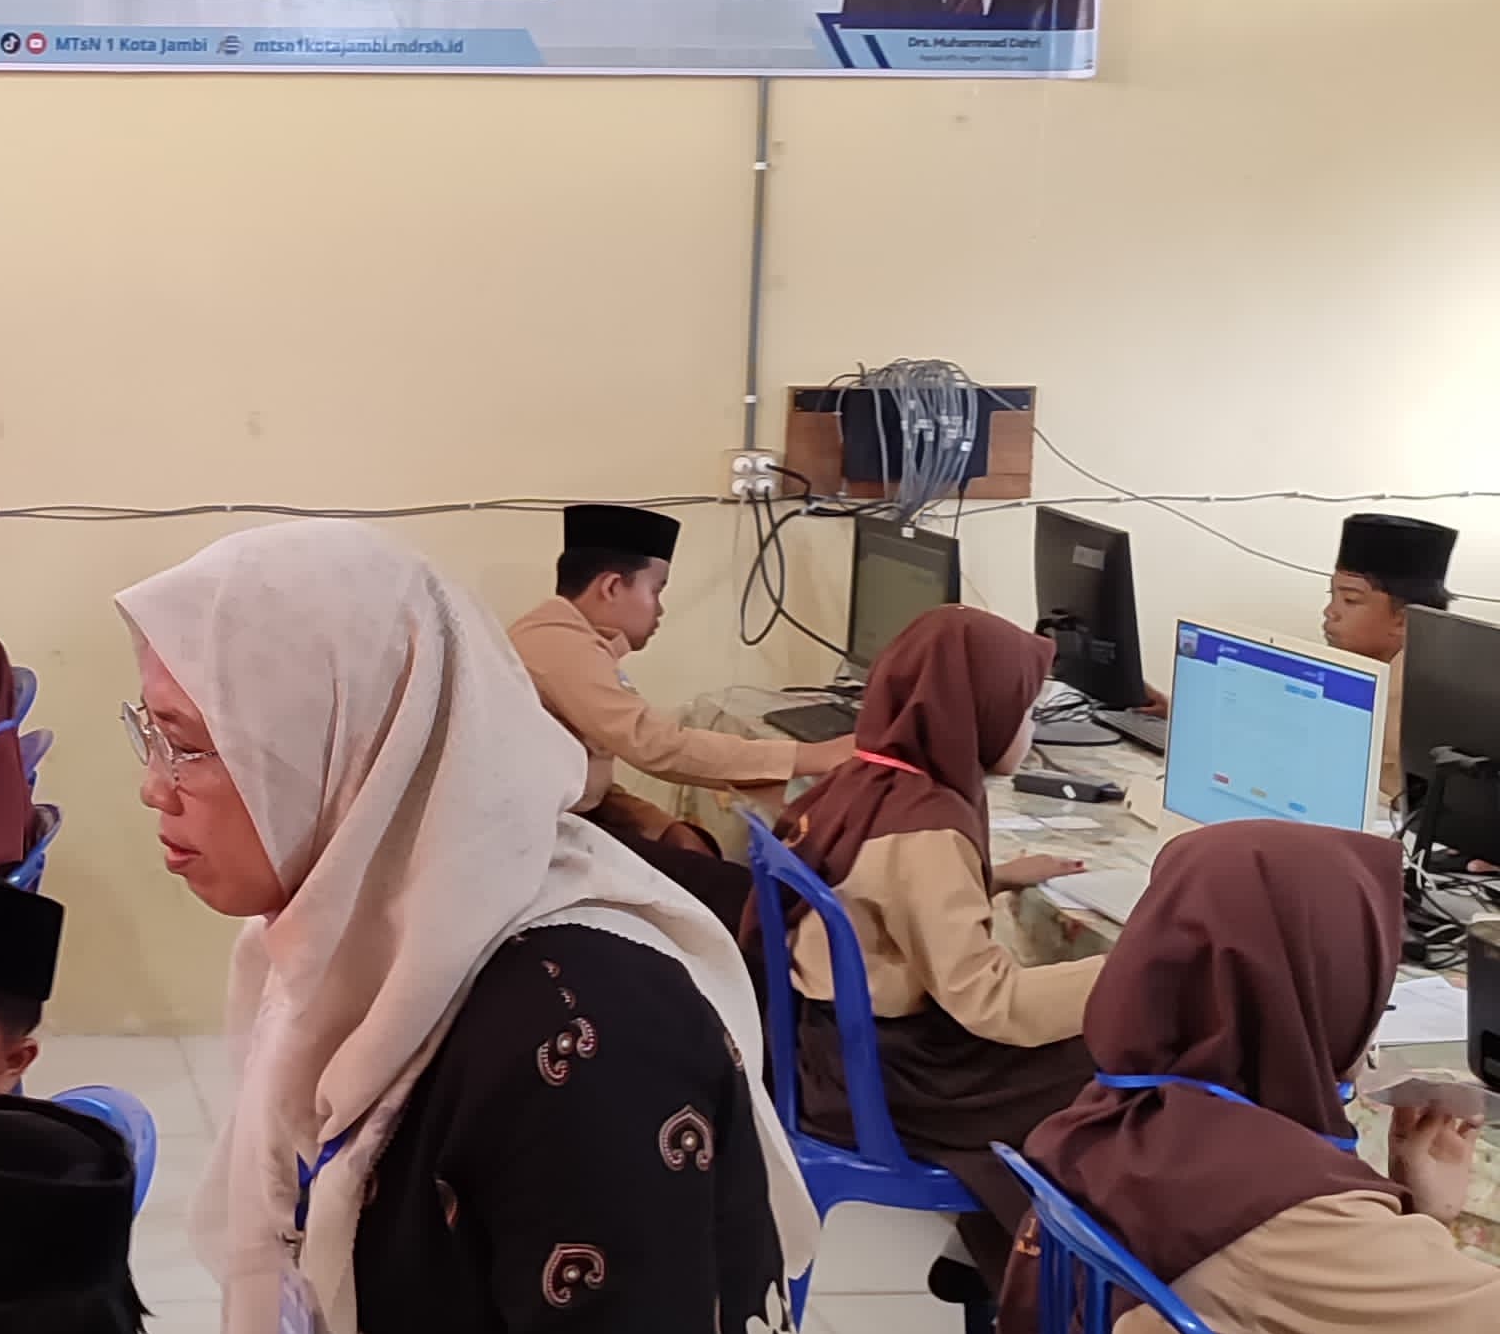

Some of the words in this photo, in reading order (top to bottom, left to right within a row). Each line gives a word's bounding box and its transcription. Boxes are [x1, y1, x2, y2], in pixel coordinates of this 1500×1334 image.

[55, 37, 101, 53] MTsN
[107, 37, 115, 53] 1
[118, 37, 157, 53] Kota
[158, 37, 208, 56] Jambi
